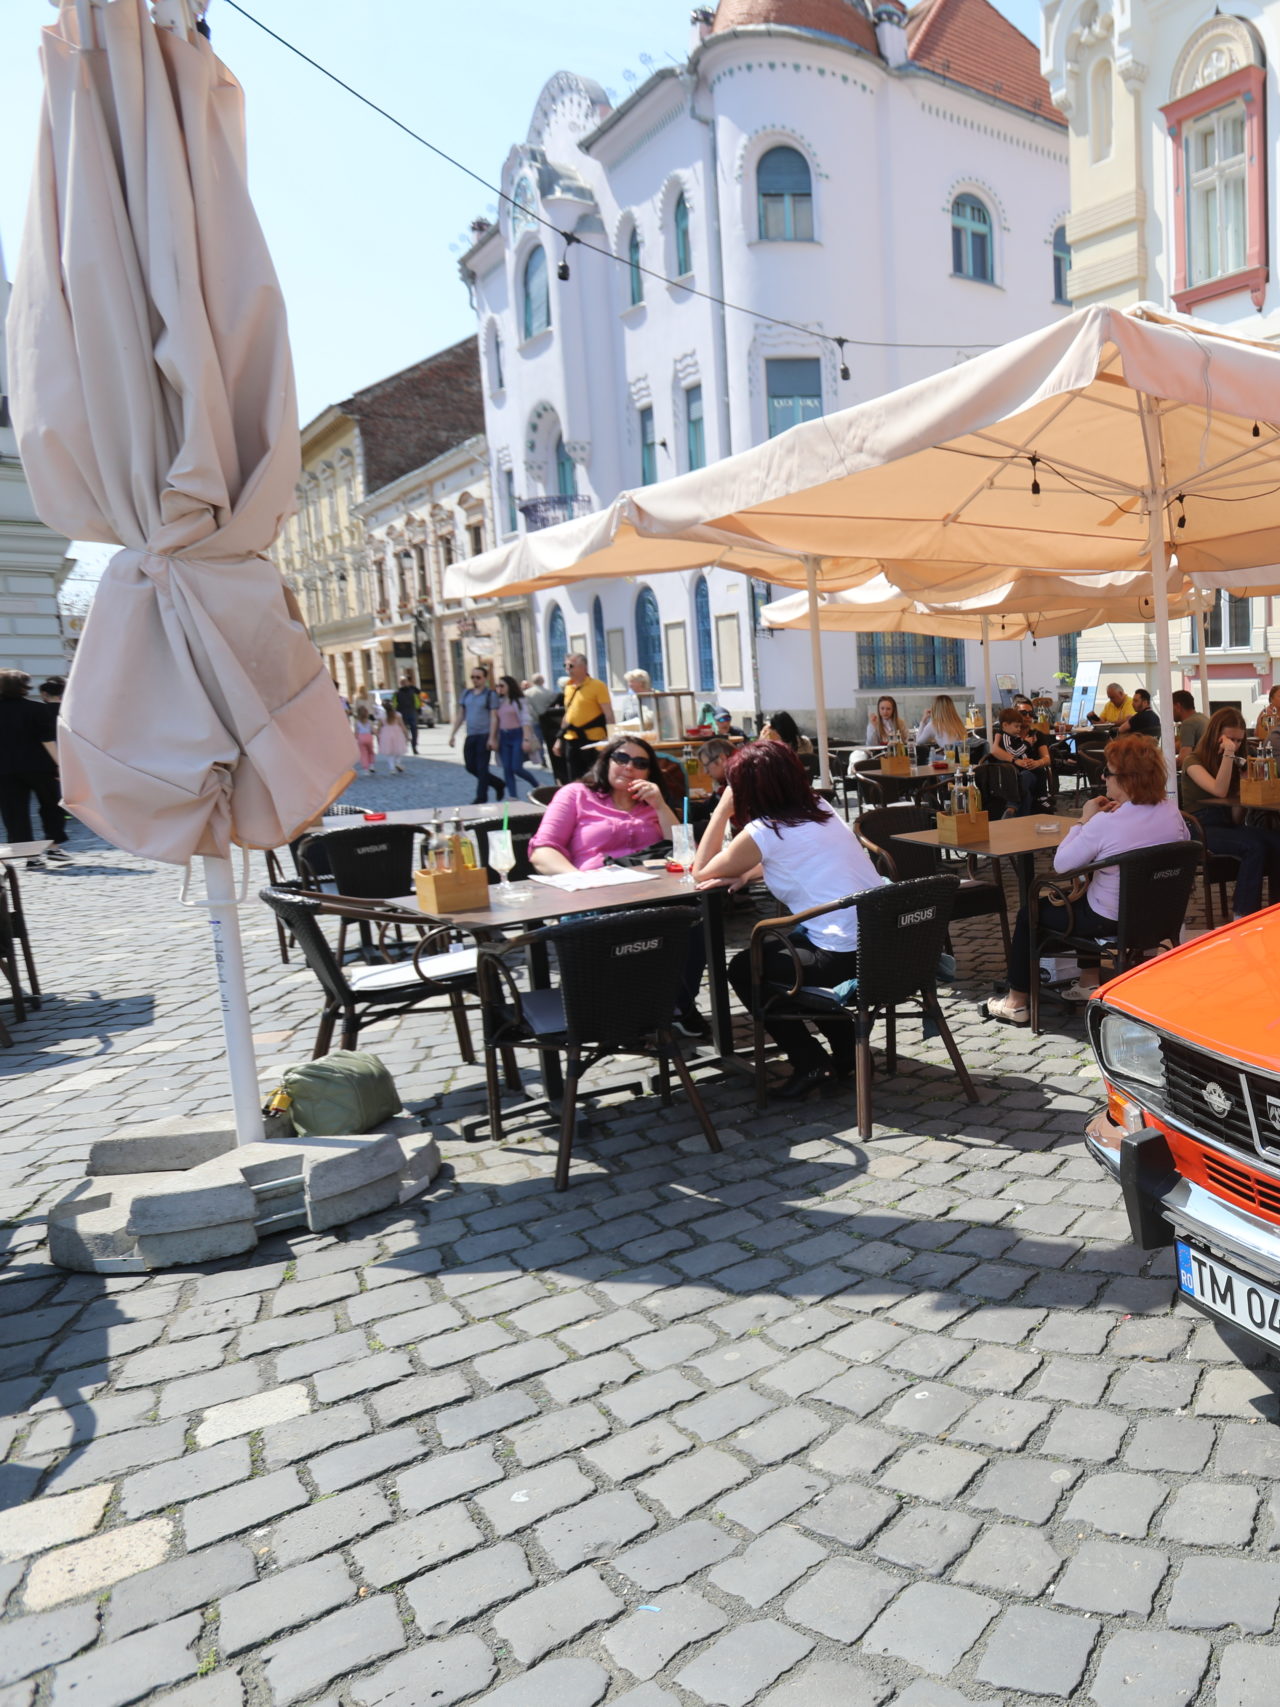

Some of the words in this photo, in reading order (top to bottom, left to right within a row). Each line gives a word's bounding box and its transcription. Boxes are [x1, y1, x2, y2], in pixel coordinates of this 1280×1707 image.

[900, 908, 933, 926] URSUS
[615, 939, 659, 956] URSUS
[1180, 1269, 1194, 1289] RO
[1191, 1254, 1236, 1315] TM
